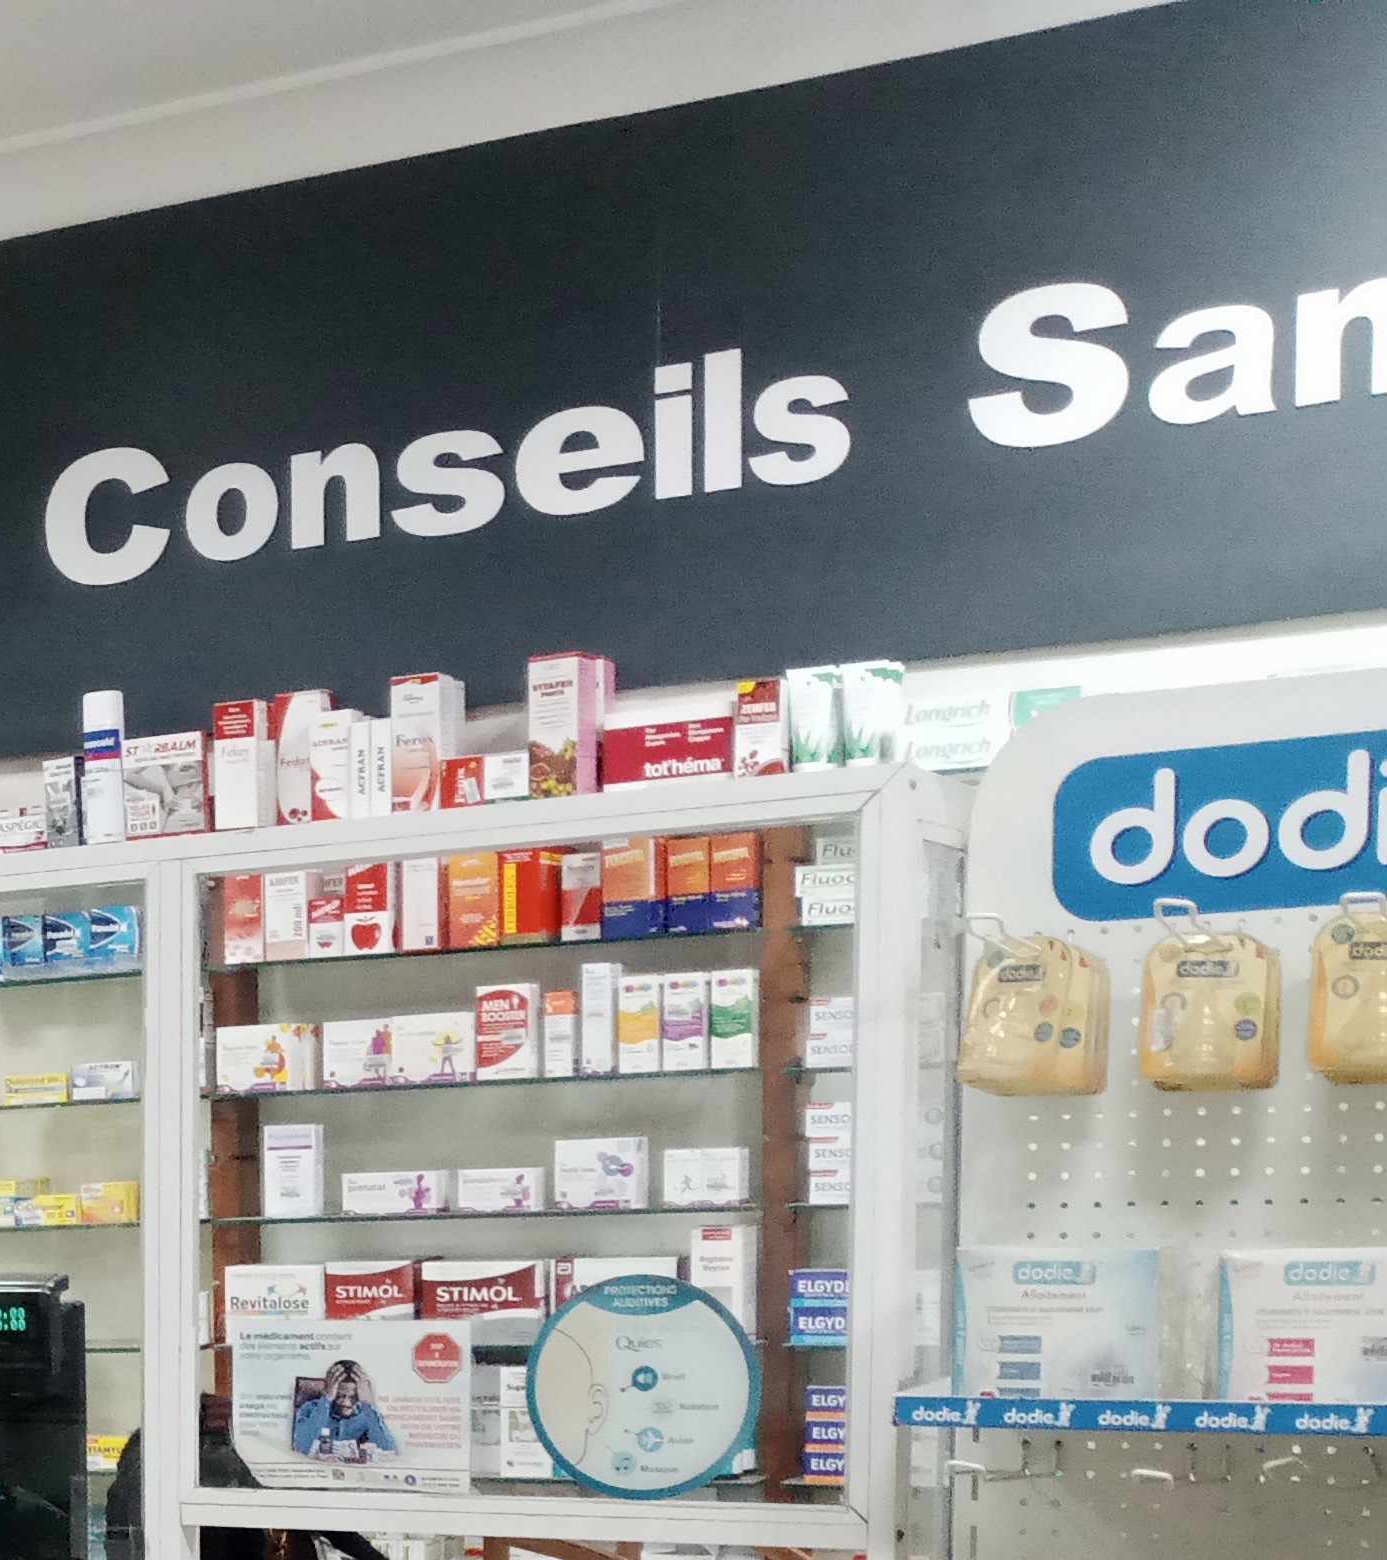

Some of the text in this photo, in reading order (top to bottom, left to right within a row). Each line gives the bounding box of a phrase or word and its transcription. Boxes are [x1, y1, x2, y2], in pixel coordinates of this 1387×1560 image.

[45, 348, 851, 586] Conseils
[904, 700, 991, 726] Longrich
[906, 738, 991, 762] Longrich
[356, 749, 366, 795] ACFRAN
[377, 746, 386, 792] ACFRAN
[643, 756, 724, 778] tot'héma
[822, 844, 856, 857] Flu
[482, 999, 510, 1011] MEN
[481, 1011, 526, 1022] BOOSTER
[1018, 1264, 1074, 1281] dodie
[1288, 1262, 1350, 1281] dodie
[604, 1285, 678, 1297] PROTECTIONS
[230, 1295, 310, 1311] Revitalose
[612, 1297, 669, 1308] AUDITIVES
[911, 1406, 1351, 1432] dodie dodie dodie dodie dodie
